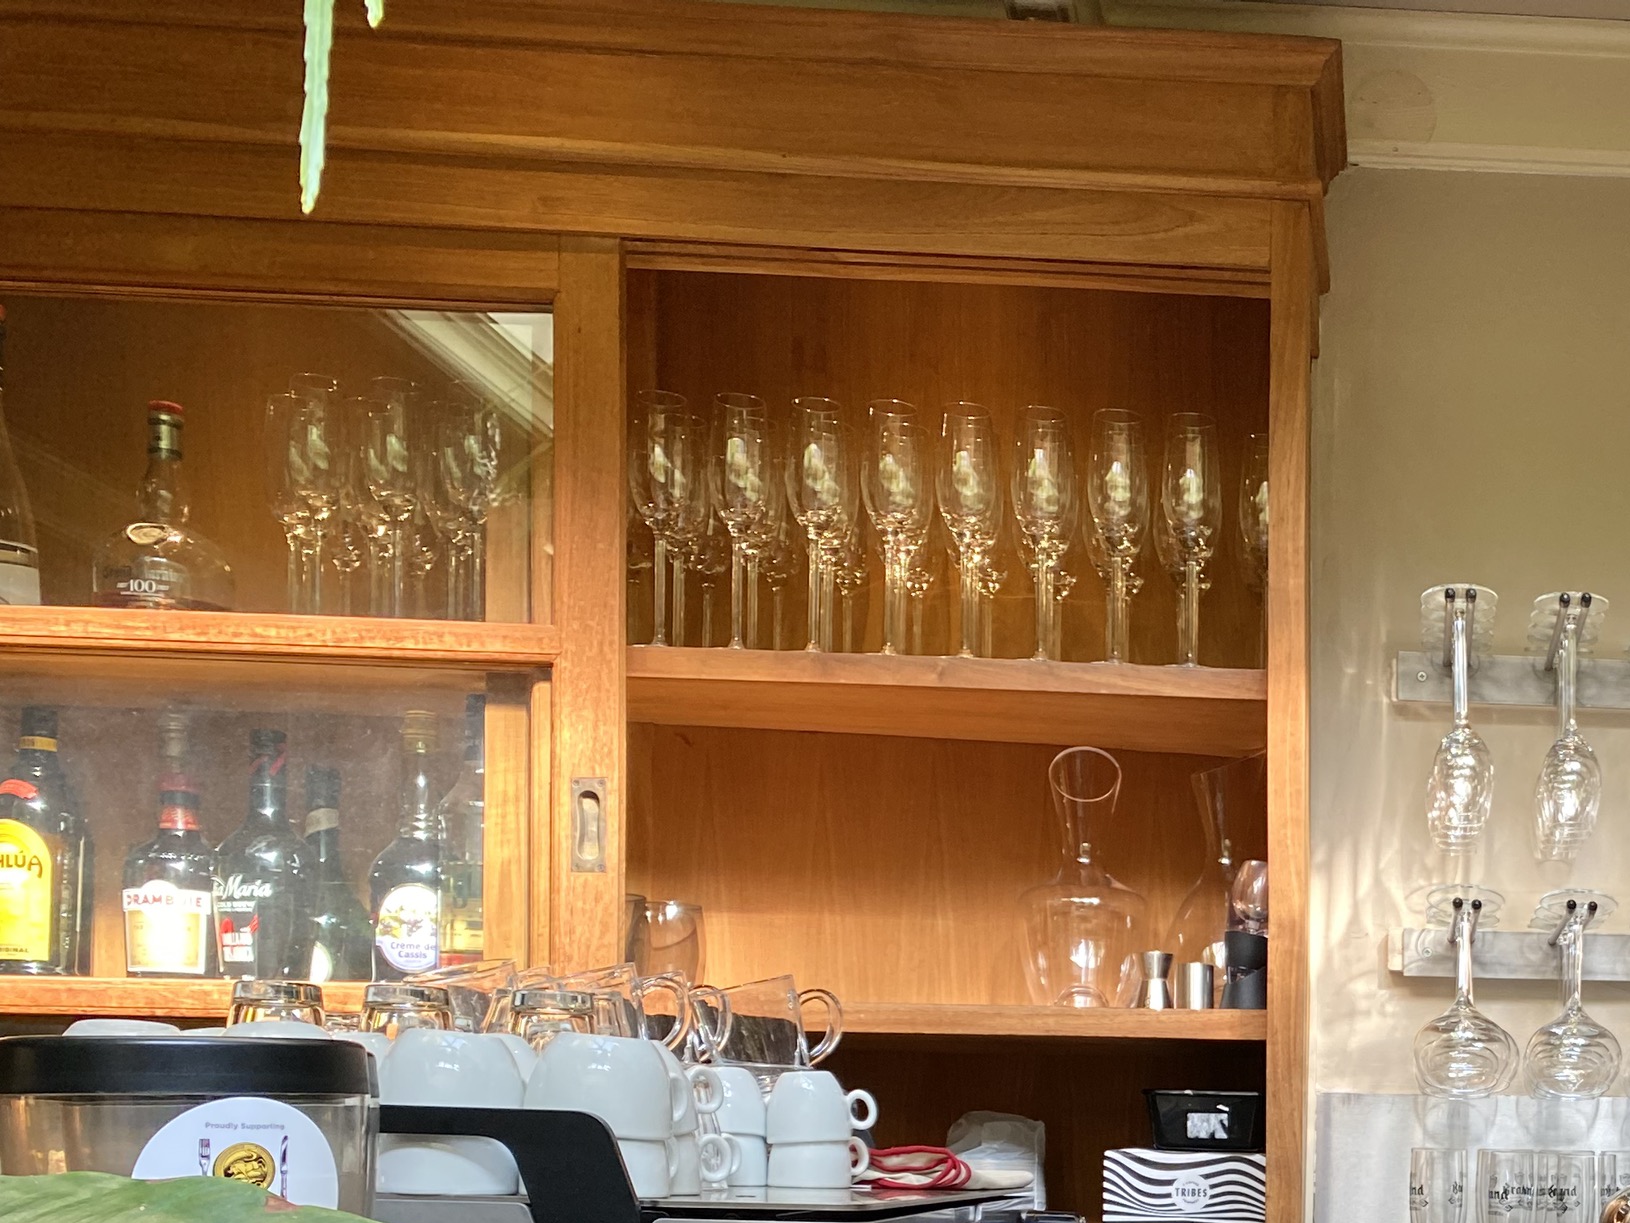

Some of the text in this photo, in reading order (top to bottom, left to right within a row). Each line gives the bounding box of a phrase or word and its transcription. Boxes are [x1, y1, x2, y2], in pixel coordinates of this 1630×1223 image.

[126, 894, 202, 908] DRAMBE
[398, 950, 428, 959] Cassis
[205, 1122, 286, 1131] Proudly Supporting
[1174, 1187, 1208, 1198] TRIBES
